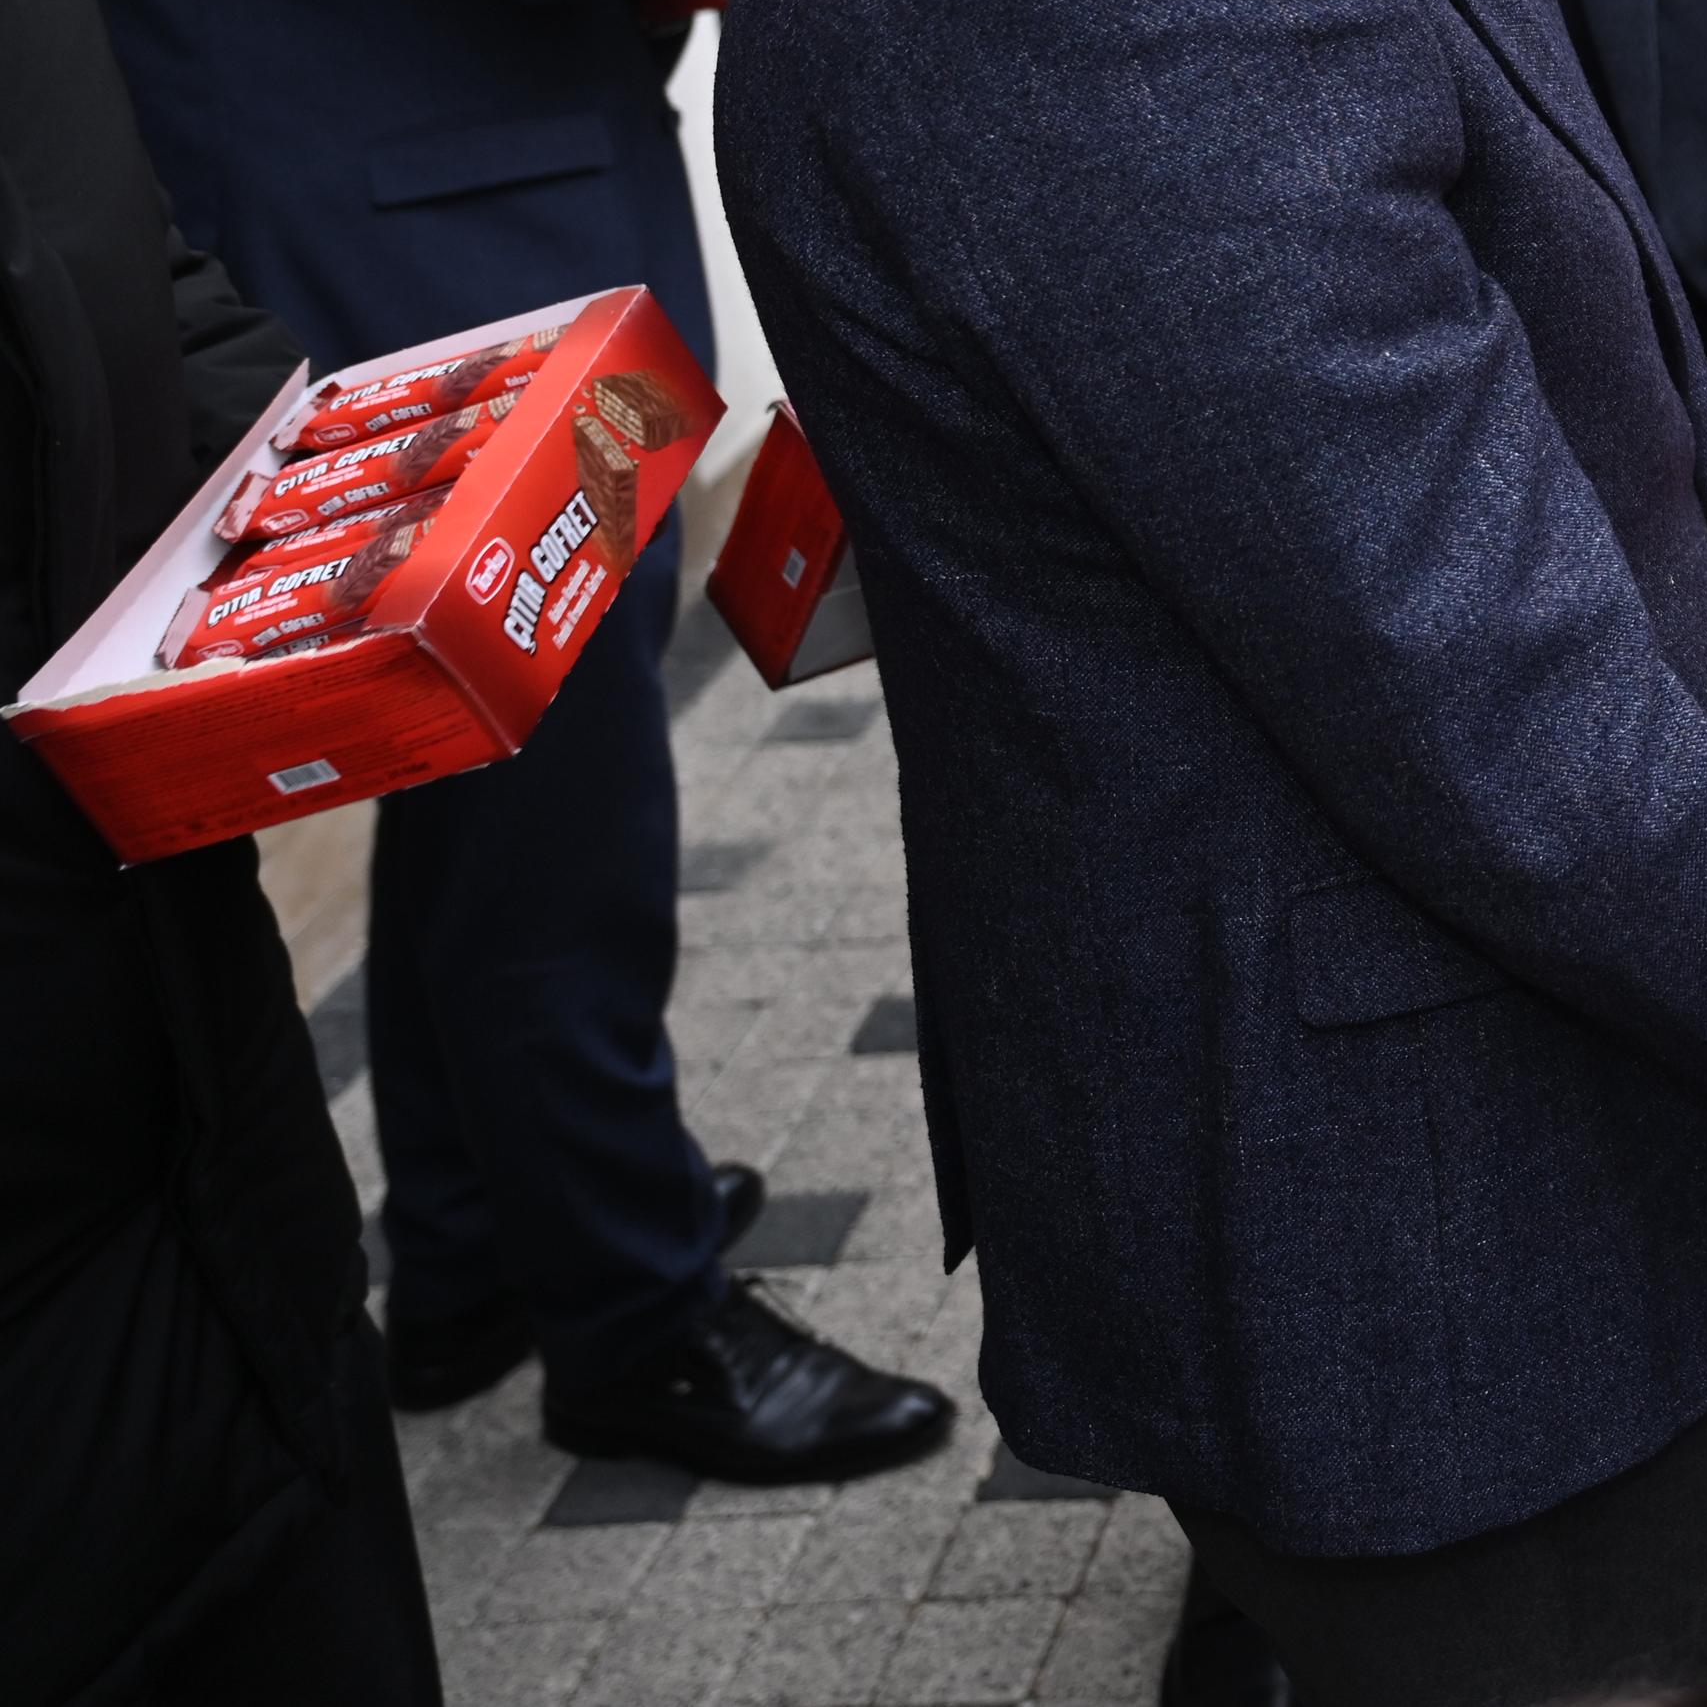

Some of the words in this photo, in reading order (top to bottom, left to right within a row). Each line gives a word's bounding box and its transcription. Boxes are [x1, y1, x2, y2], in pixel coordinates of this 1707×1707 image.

[387, 358, 467, 389] GOFRET
[274, 461, 329, 499] ÇITIR
[333, 432, 420, 470] GOFRET
[207, 585, 264, 630] ÇITIR
[266, 555, 353, 598] GOFRET
[503, 570, 548, 656] ÇITIR
[529, 488, 600, 584] GOFRET
